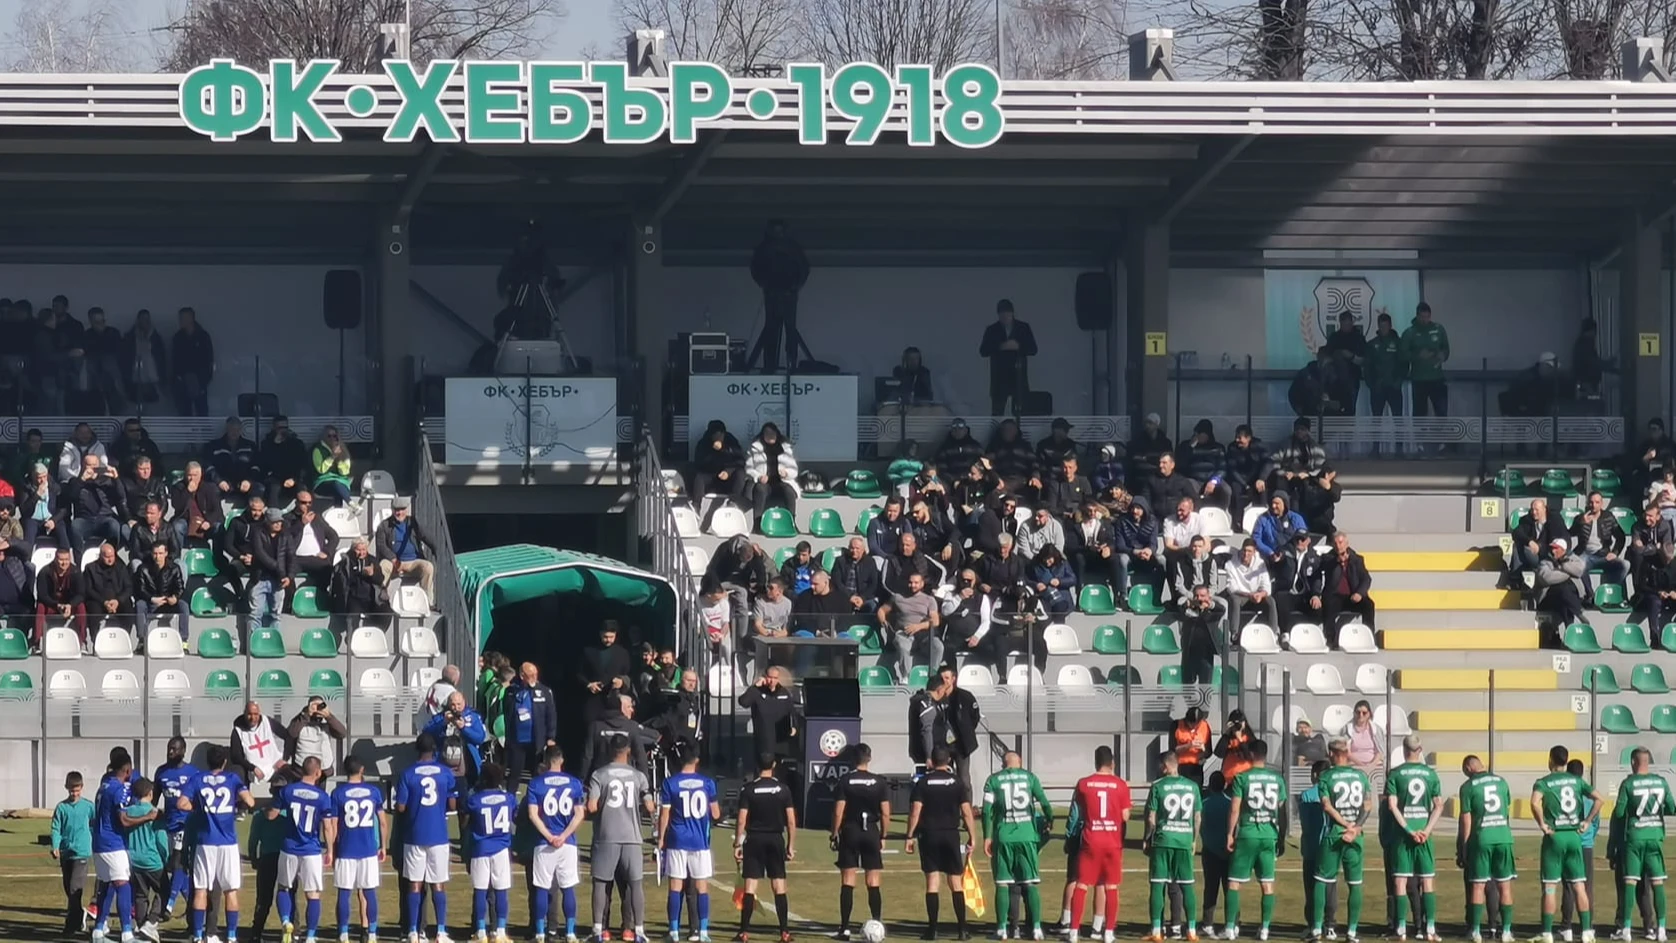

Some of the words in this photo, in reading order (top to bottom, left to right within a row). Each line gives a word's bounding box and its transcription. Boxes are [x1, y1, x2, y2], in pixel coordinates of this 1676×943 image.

[179, 58, 342, 143] ФК
[381, 58, 733, 144] ХЕБЪР
[787, 61, 1005, 149] 1918
[484, 385, 510, 398] ФК
[518, 385, 572, 398] ХЕБЪР
[727, 383, 751, 396] ФК
[1486, 507, 1493, 516] 8
[1504, 544, 1510, 553] 7
[1558, 662, 1565, 671] 4
[1577, 702, 1583, 711] 3
[1596, 743, 1603, 752] 2
[201, 786, 233, 814] 22
[420, 776, 438, 806] 3
[543, 788, 573, 816] 66
[607, 779, 634, 808] 31
[679, 790, 708, 819] 10
[1000, 782, 1030, 810] 15
[1097, 790, 1107, 818] 1
[1247, 782, 1279, 810] 55
[1333, 781, 1363, 808] 28
[1408, 778, 1425, 805] 9
[1484, 785, 1501, 812] 5
[1560, 786, 1577, 813] 8
[1633, 788, 1665, 816] 77
[290, 802, 315, 833] 11
[344, 799, 374, 828] 82
[481, 806, 510, 834] 14
[1164, 793, 1194, 819] 99
